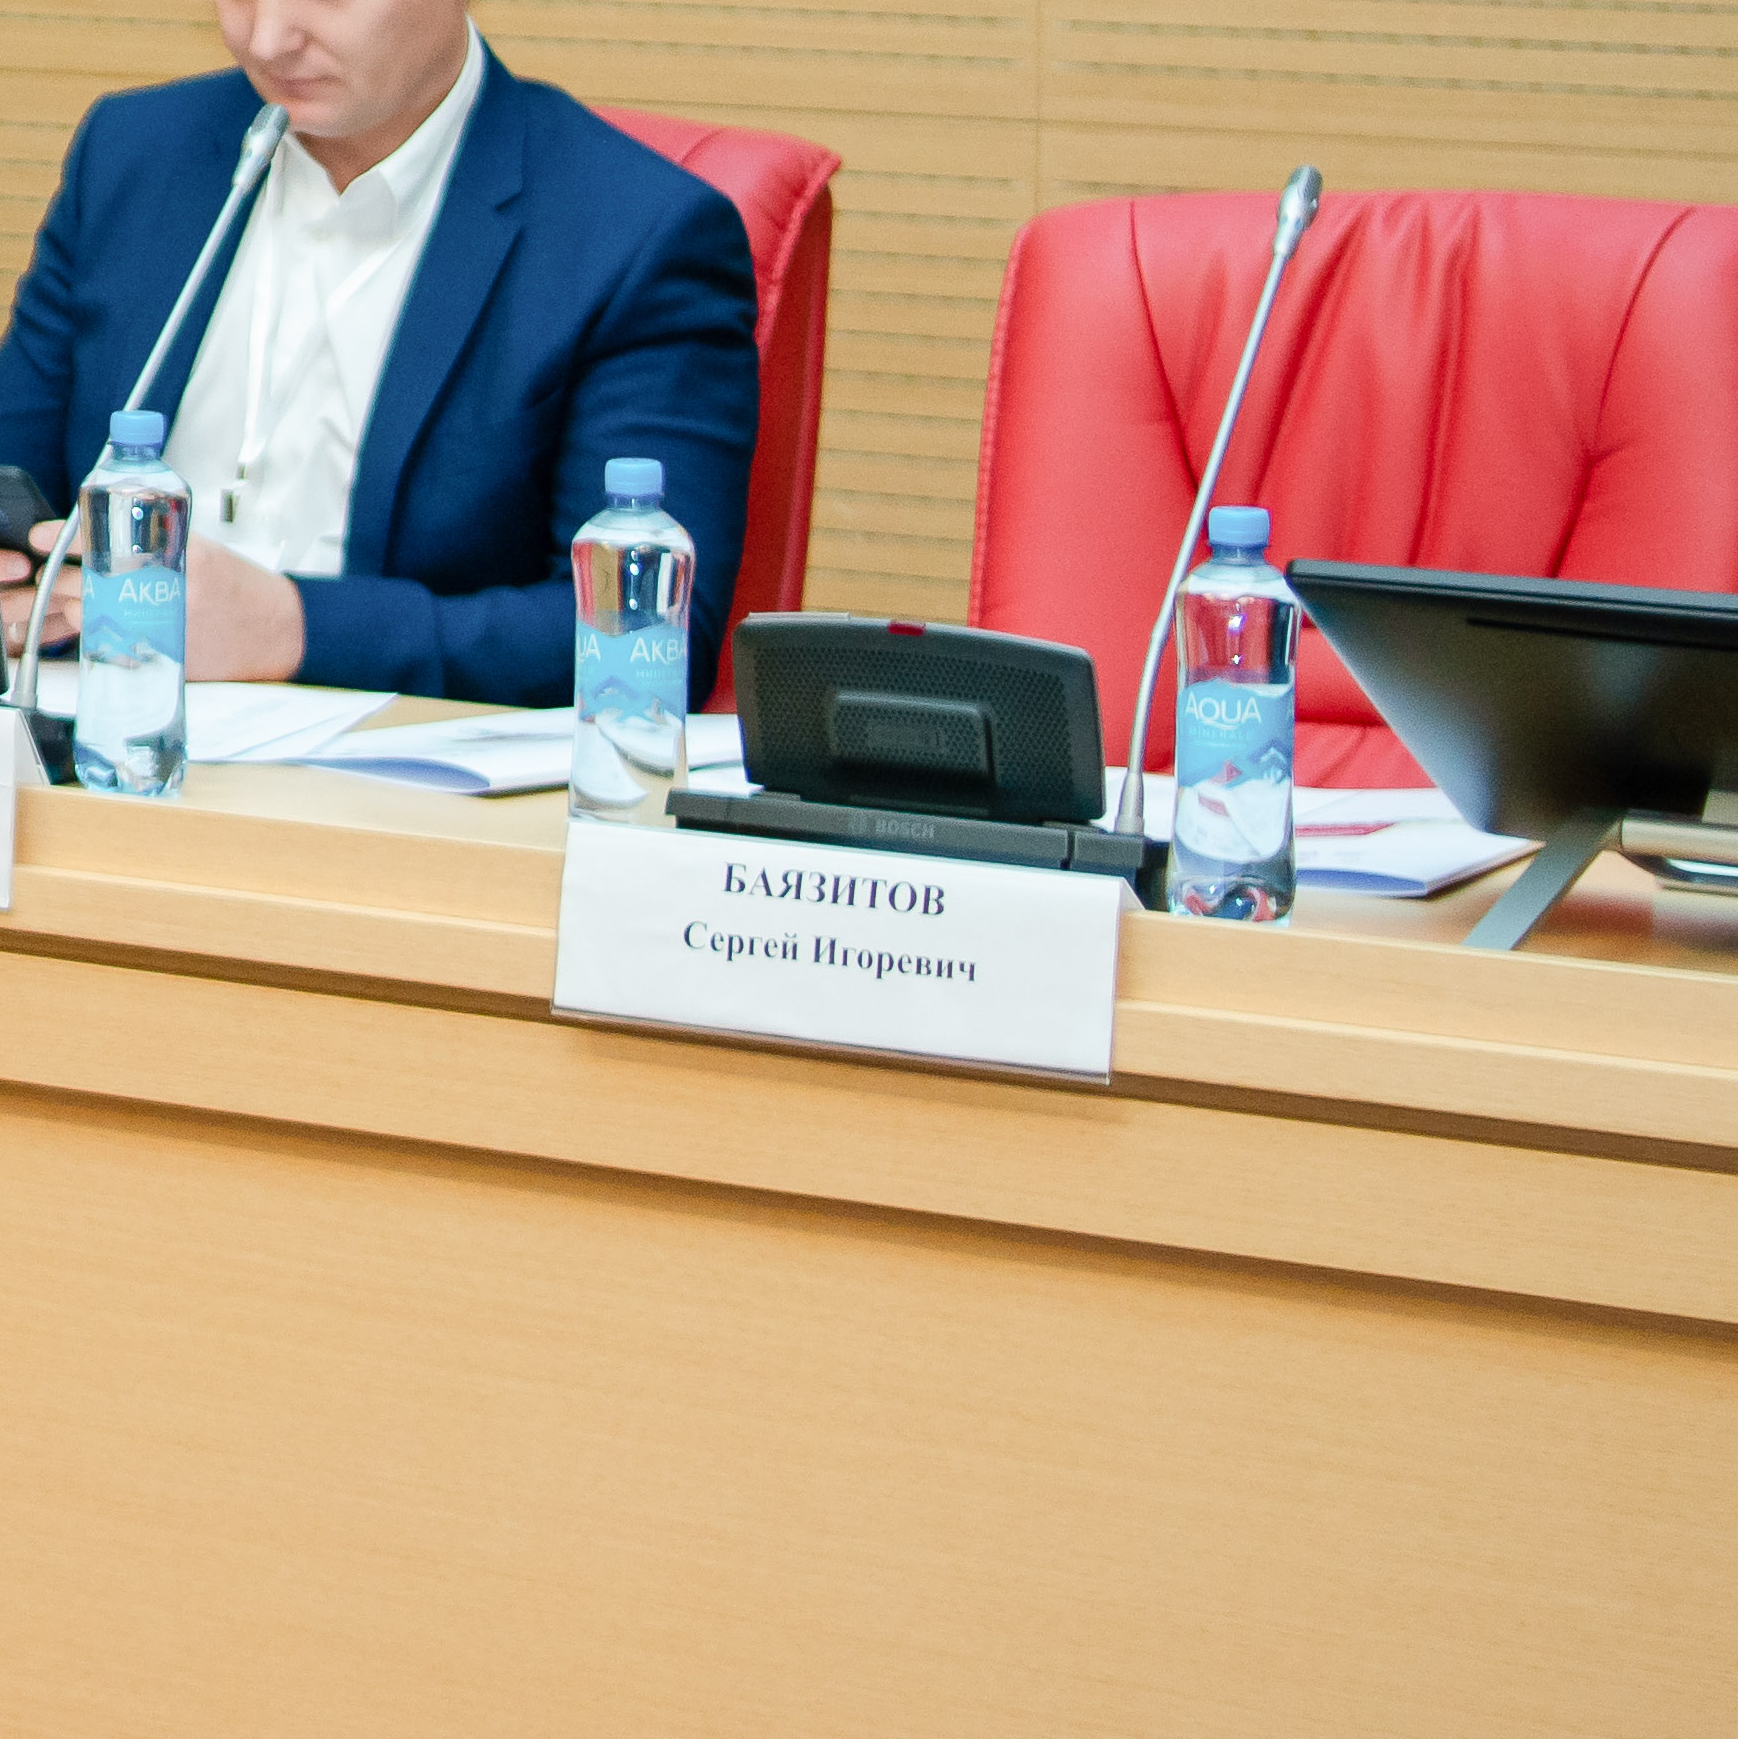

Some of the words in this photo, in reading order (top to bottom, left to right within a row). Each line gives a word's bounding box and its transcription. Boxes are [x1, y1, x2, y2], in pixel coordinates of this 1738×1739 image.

[1184, 691, 1263, 731] AQUA
[724, 861, 946, 917] БАЯЗИТОВ
[682, 920, 799, 962] Сергей
[812, 935, 977, 983] Игоревич
